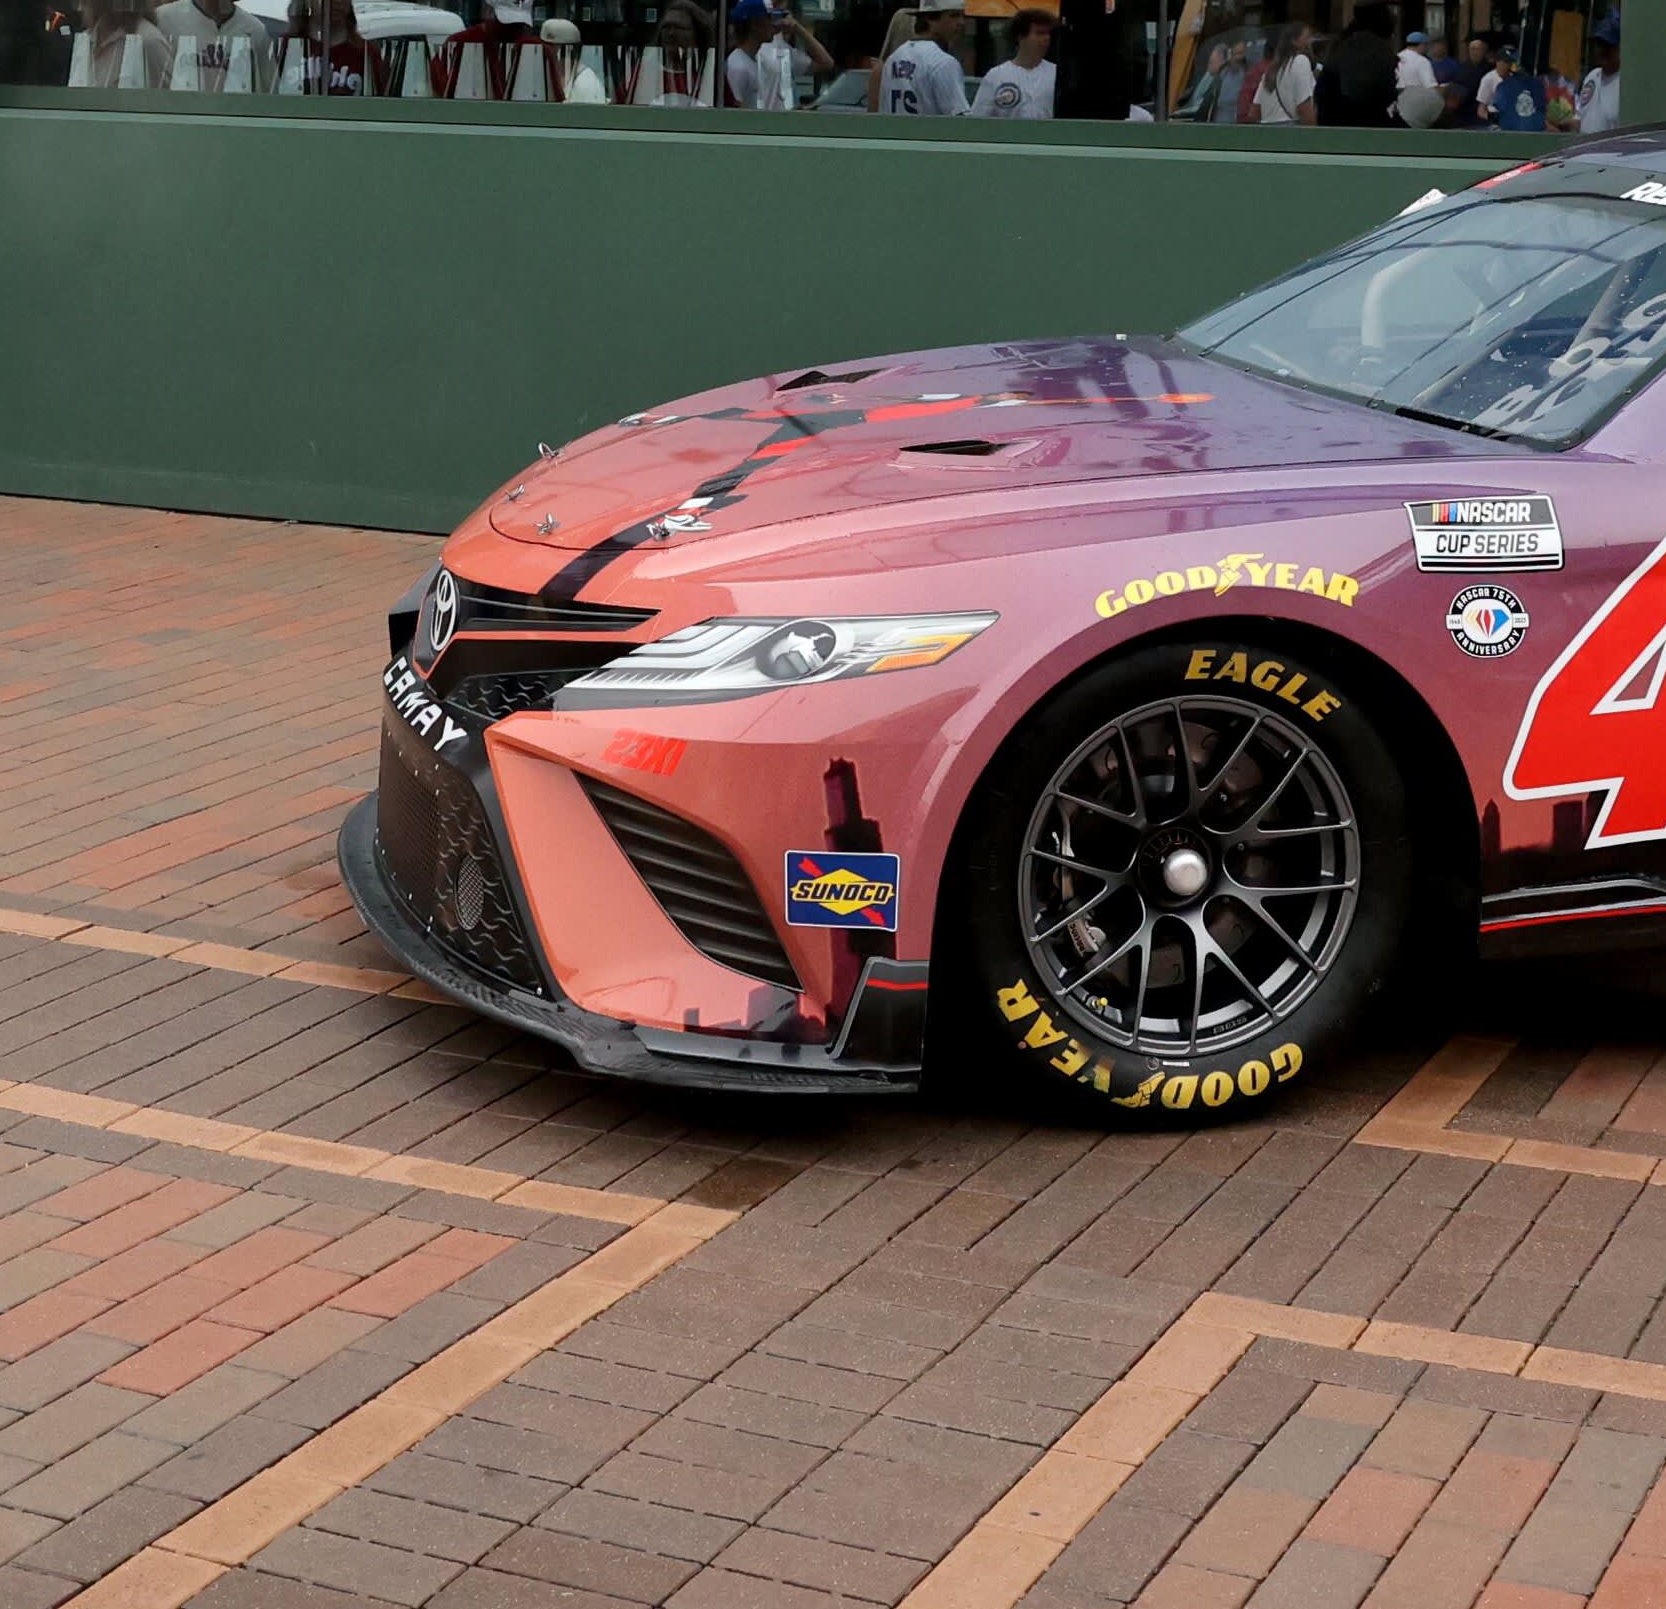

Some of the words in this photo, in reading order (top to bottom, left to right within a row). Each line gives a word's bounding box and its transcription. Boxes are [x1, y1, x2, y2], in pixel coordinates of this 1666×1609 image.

[1456, 501, 1531, 523] NASCAR
[1436, 533, 1471, 554] CUP
[1474, 532, 1539, 554] SERIES
[1095, 557, 1359, 619] GOODYEAR
[1455, 587, 1491, 611] NASCAR
[1492, 587, 1517, 610] 75TH
[1455, 628, 1521, 656] ANNIVERSARY
[1184, 649, 1342, 723] EAGLE
[792, 876, 895, 906] SUNOCO
[997, 978, 1305, 1110] GOODYEAR
